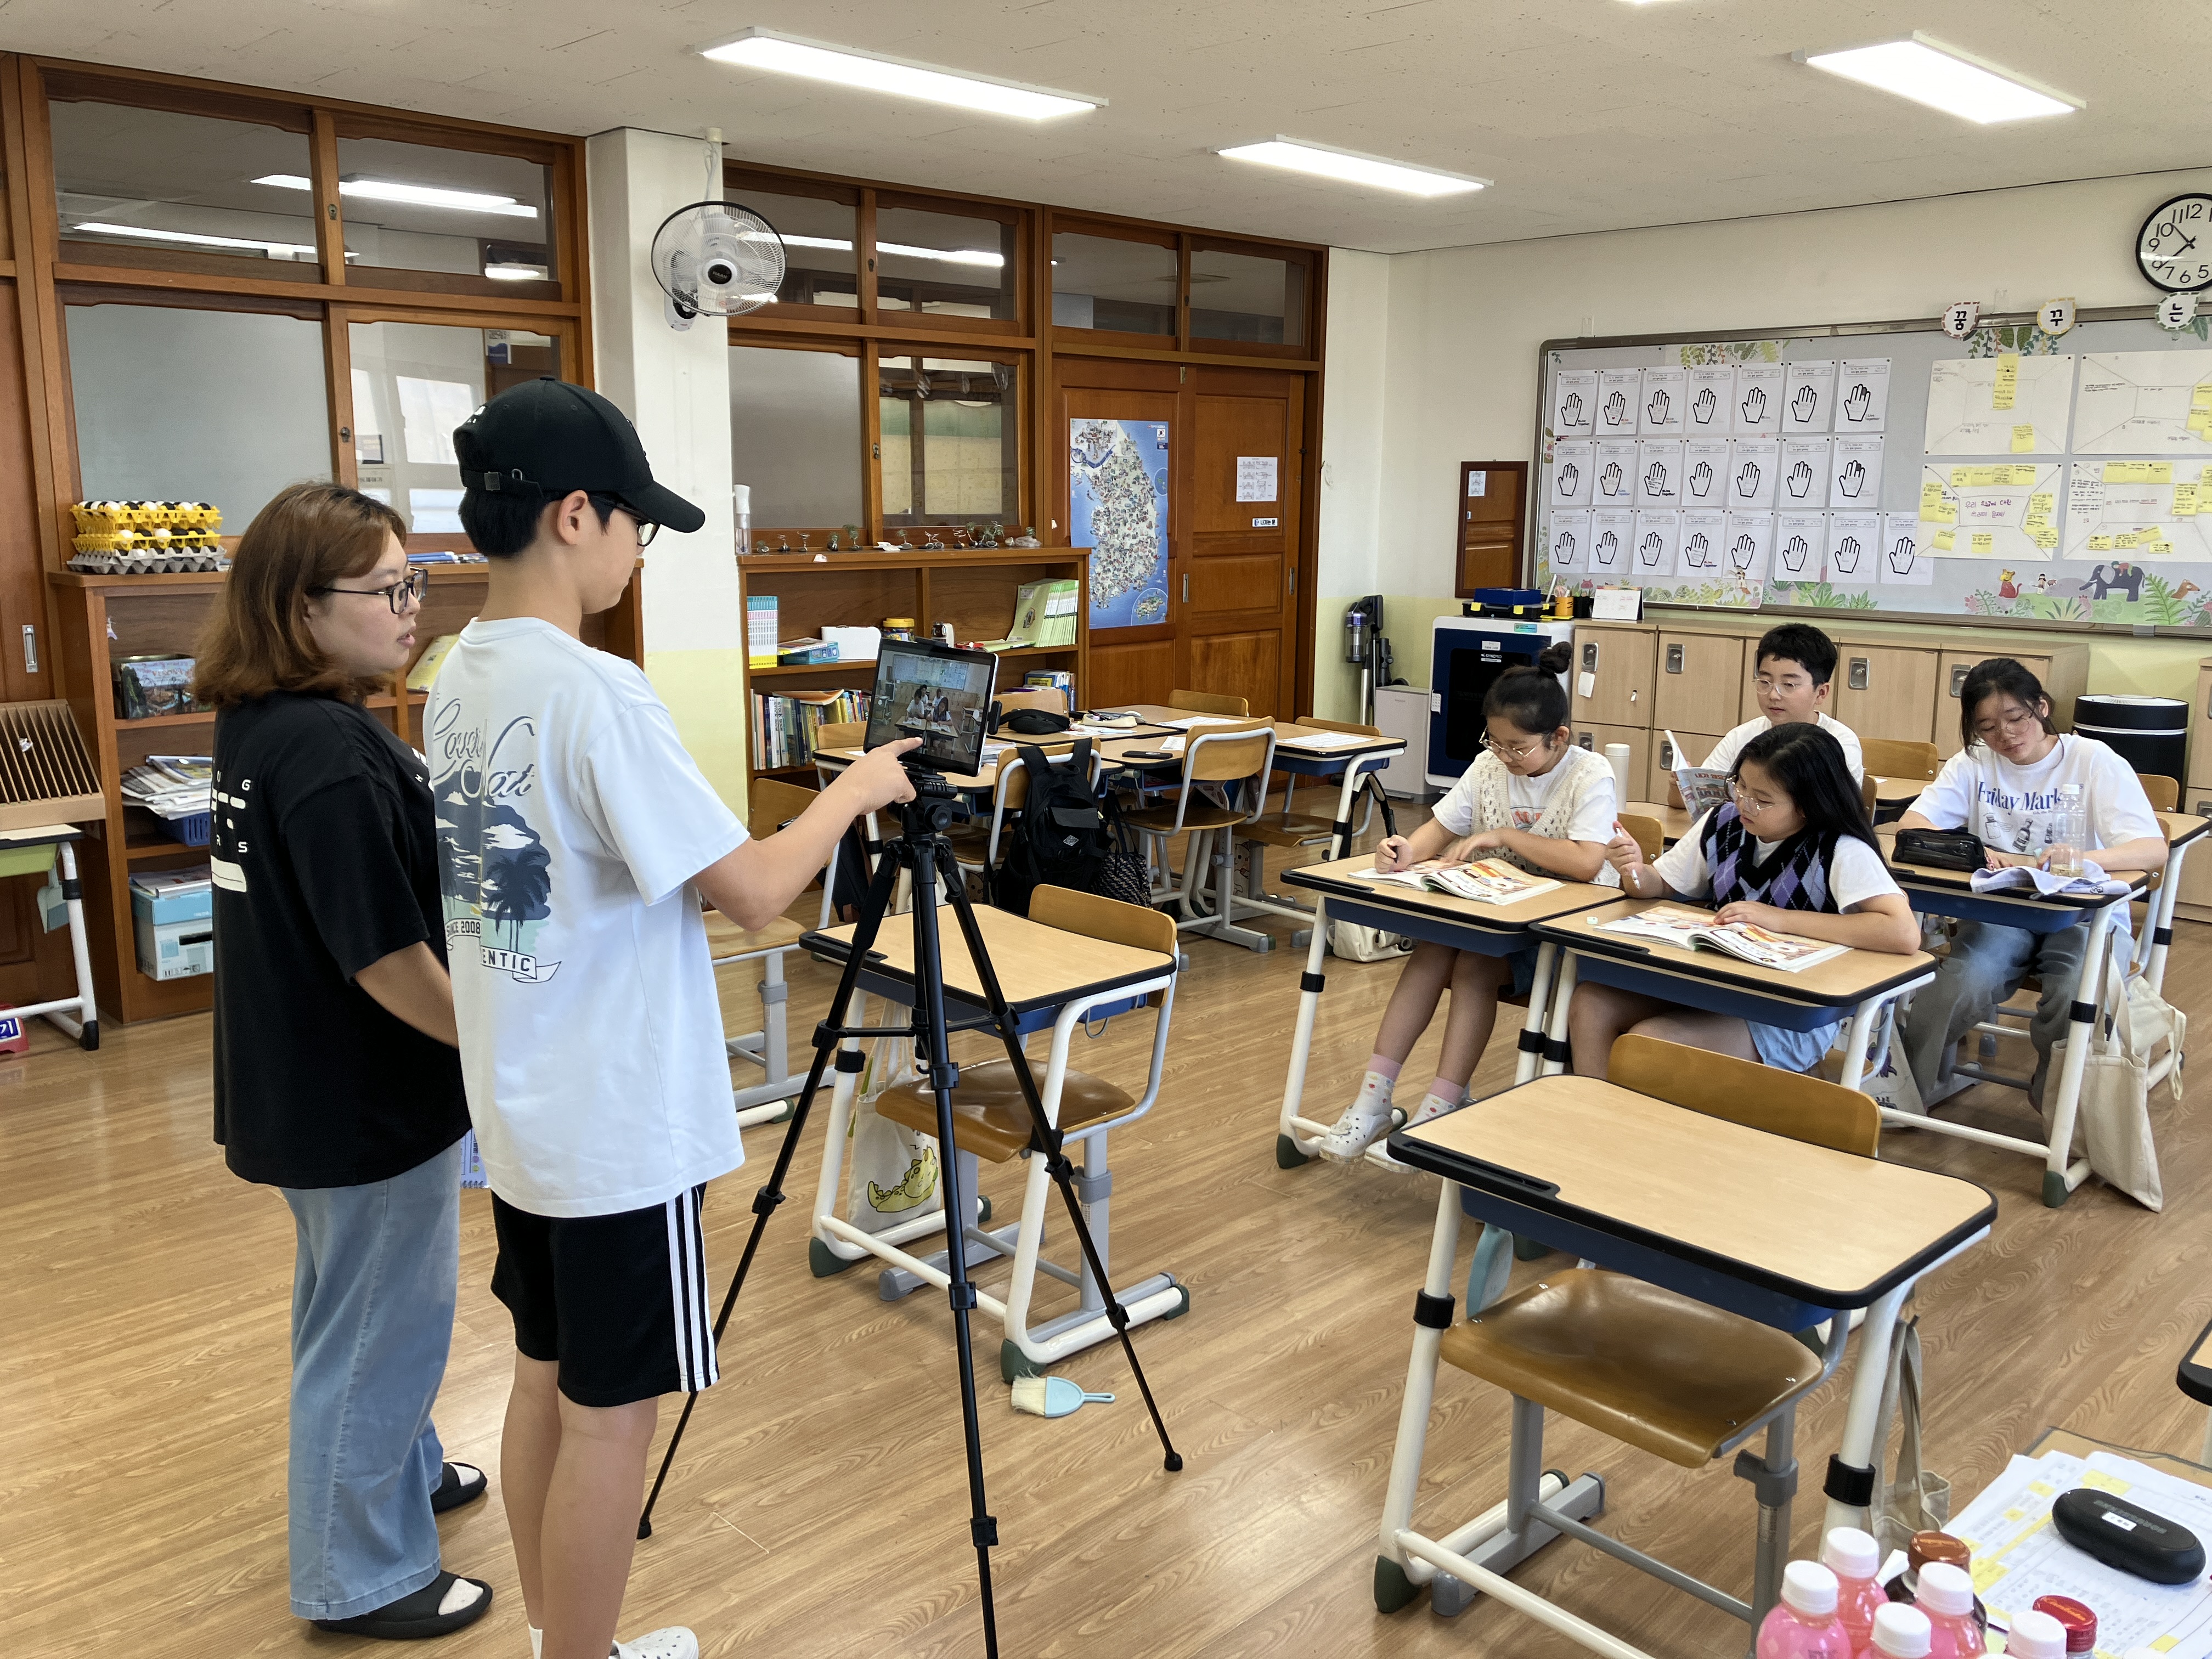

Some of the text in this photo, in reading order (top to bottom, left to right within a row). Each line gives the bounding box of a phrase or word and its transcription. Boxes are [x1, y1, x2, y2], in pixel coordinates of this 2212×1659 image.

[2172, 209, 2183, 224] 11
[2186, 203, 2202, 219] 12
[2155, 222, 2174, 237] 10
[2148, 238, 2160, 252] 9
[2165, 266, 2176, 279] 7
[2180, 270, 2191, 283] 6
[2197, 264, 2209, 279] 5
[1955, 303, 2183, 330] 꿈 꾸 는
[1965, 501, 1976, 509] 우리
[1978, 781, 2021, 816] Friday
[461, 921, 481, 934] 2008
